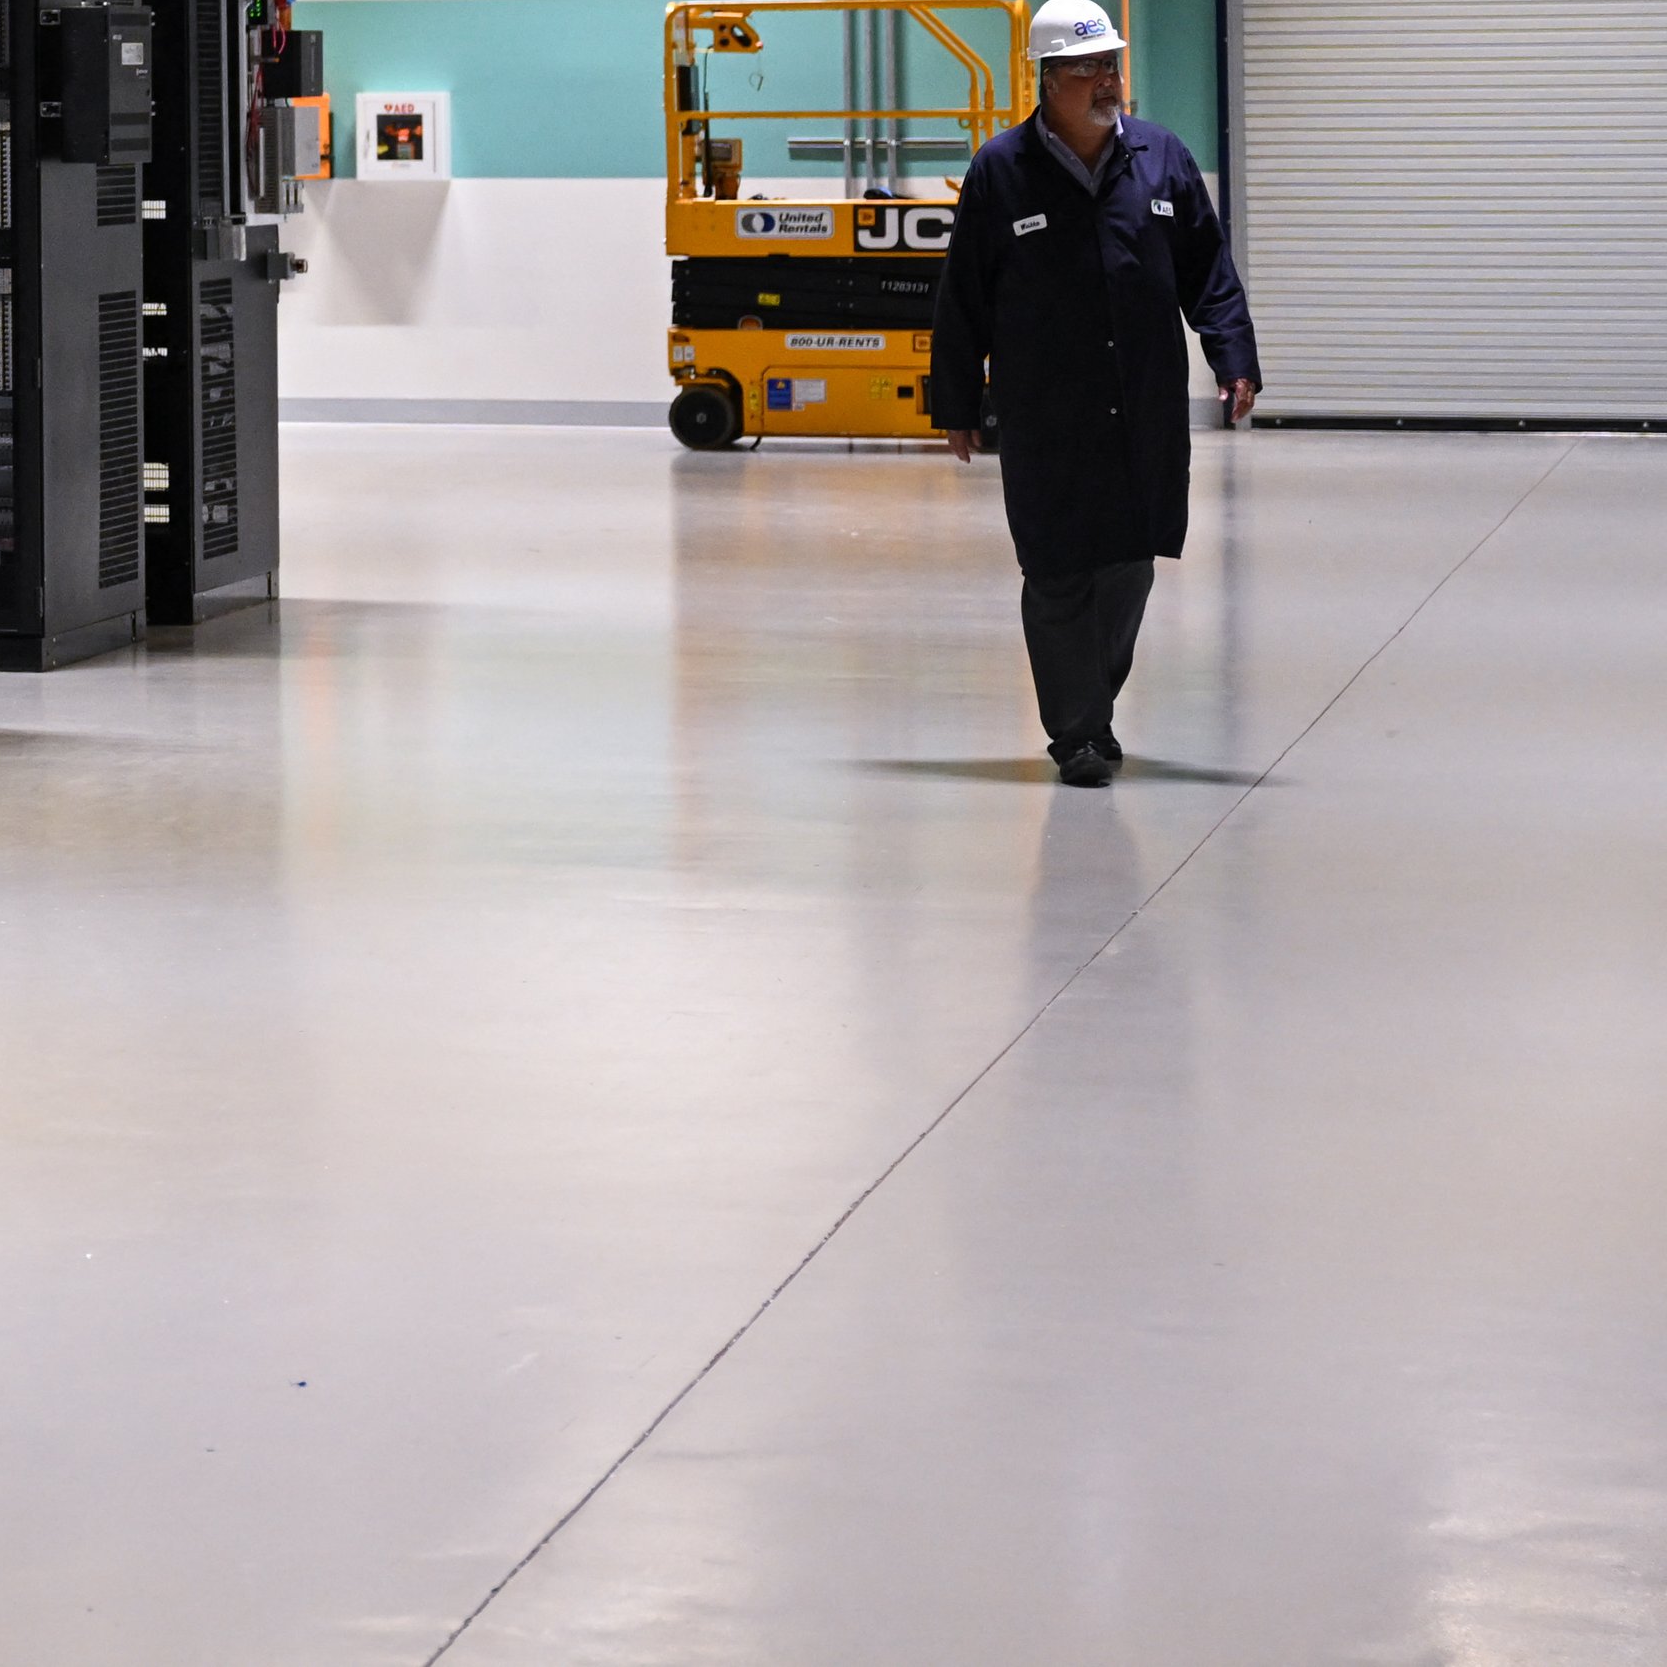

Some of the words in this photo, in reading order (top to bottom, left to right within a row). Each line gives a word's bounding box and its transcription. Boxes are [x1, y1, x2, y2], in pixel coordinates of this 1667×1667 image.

[1074, 18, 1106, 37] aes
[394, 104, 415, 113] AED
[779, 212, 824, 223] United
[779, 224, 828, 234] Rentals
